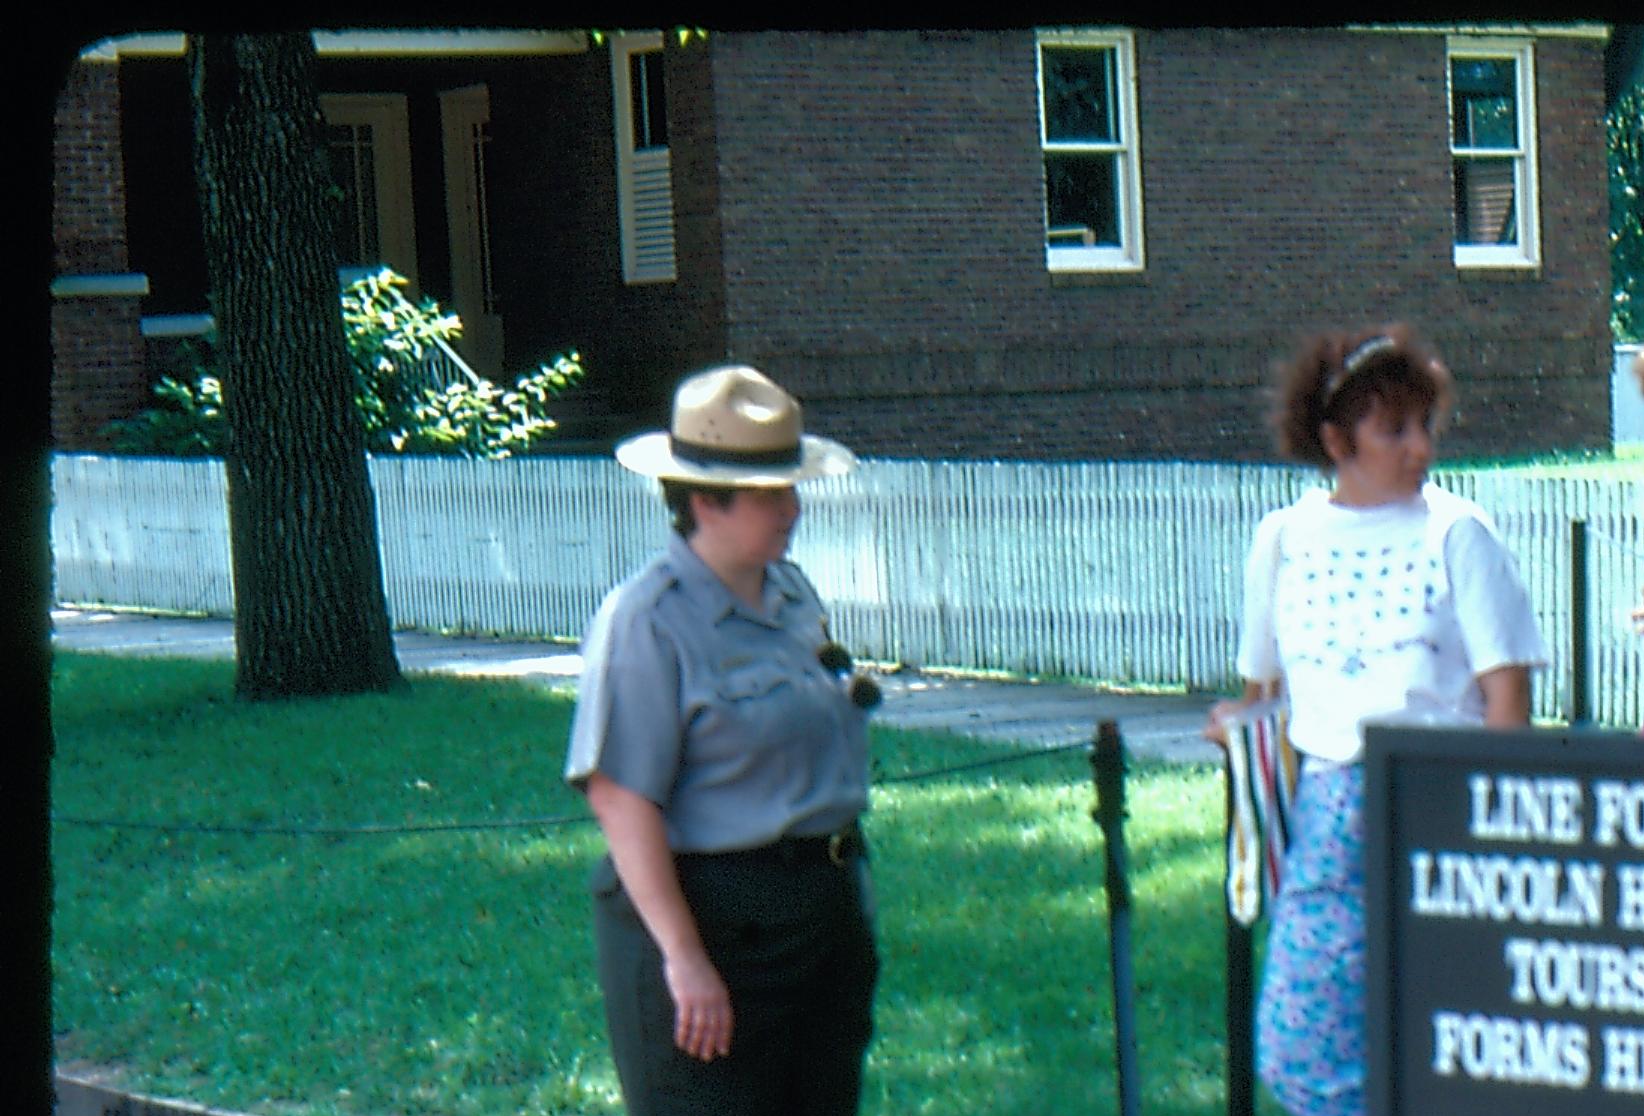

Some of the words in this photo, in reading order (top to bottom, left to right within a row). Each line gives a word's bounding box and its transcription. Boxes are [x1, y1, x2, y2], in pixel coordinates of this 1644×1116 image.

[1470, 774, 1582, 844] LINE
[1412, 851, 1605, 927] LINCOLN
[1434, 1012, 1590, 1089] FORMS
